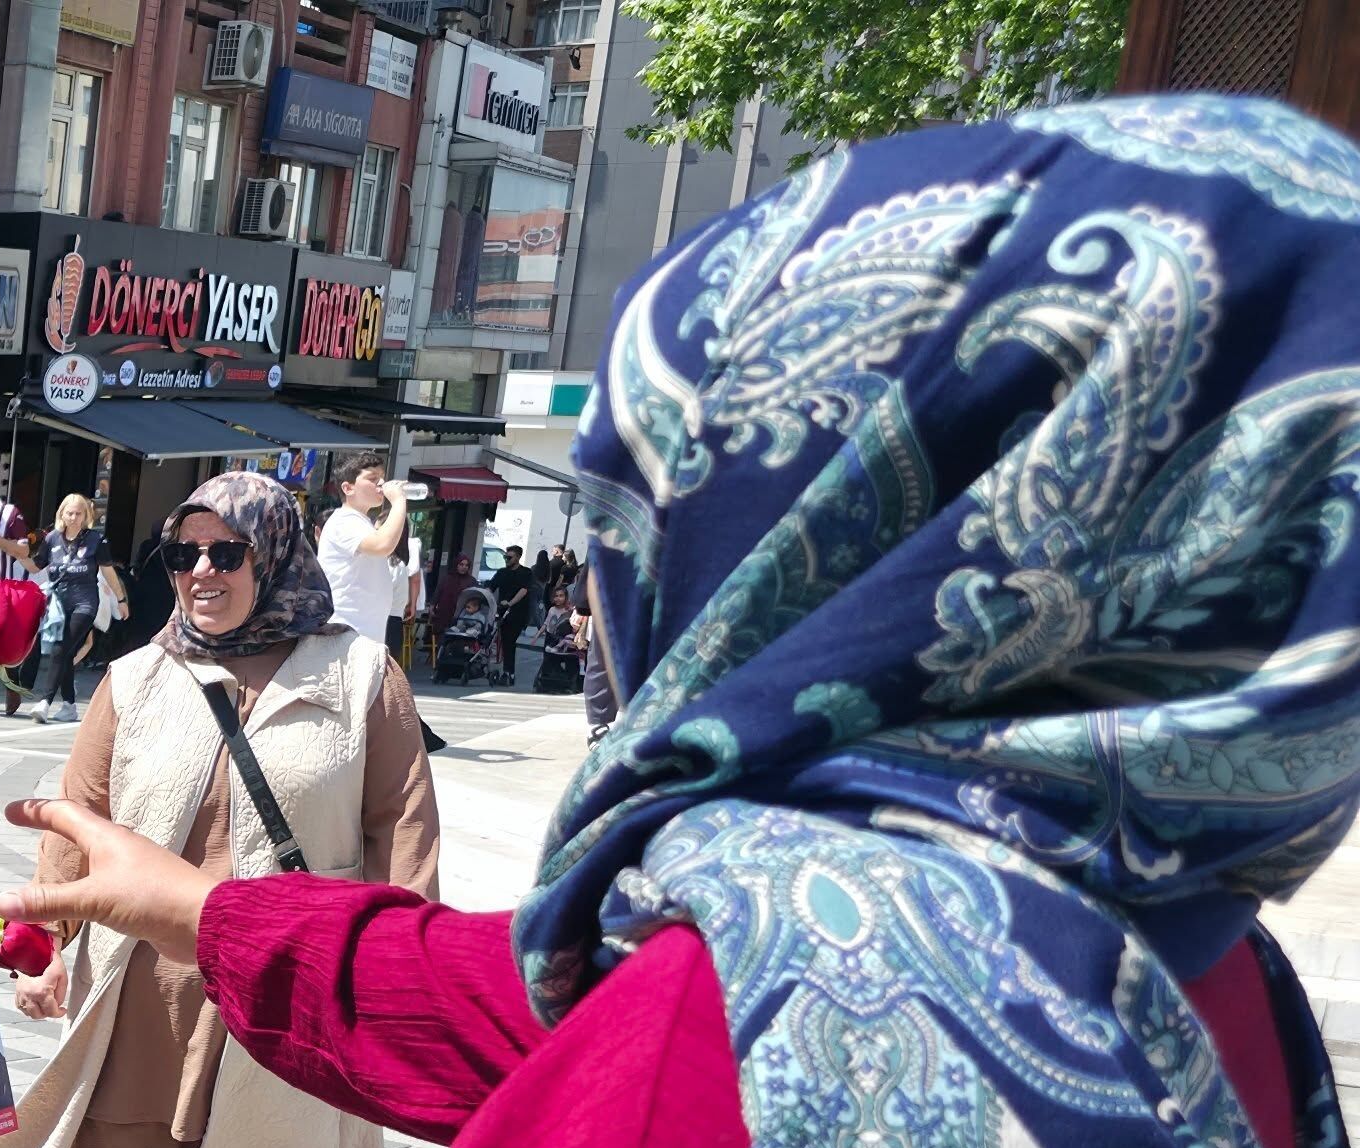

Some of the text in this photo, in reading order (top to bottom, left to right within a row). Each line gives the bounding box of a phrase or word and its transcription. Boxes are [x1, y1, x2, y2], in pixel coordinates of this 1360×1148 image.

[302, 106, 322, 130] AXA
[323, 108, 361, 139] SİGORTA
[88, 258, 280, 354] DÖNERCİ YASER
[50, 374, 90, 386] DÖNERCİ
[137, 369, 174, 387] Lezzetin
[174, 370, 202, 388] Adresi
[49, 387, 86, 402] YASER
